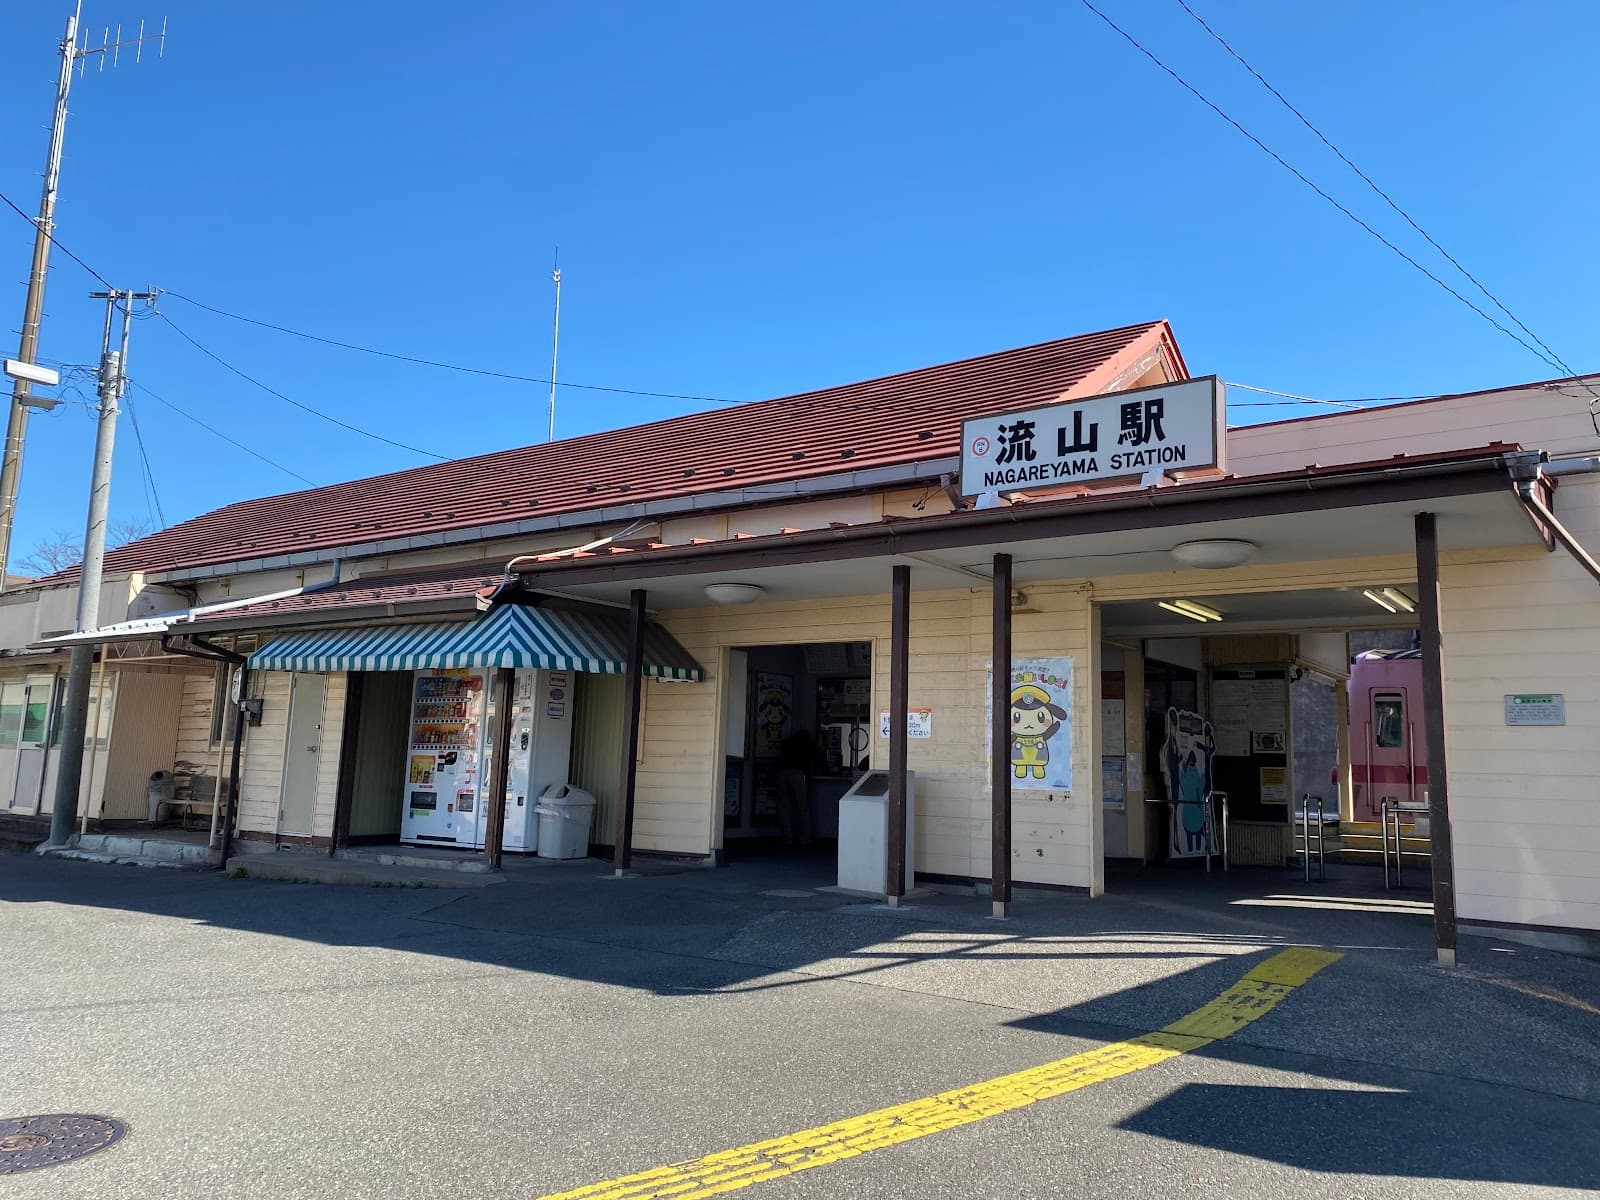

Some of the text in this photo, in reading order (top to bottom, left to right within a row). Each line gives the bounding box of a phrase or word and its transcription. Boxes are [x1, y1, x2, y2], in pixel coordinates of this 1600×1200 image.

[996, 398, 1167, 465] 流山駅
[984, 444, 1187, 486] NAGAREYAMA STATION
